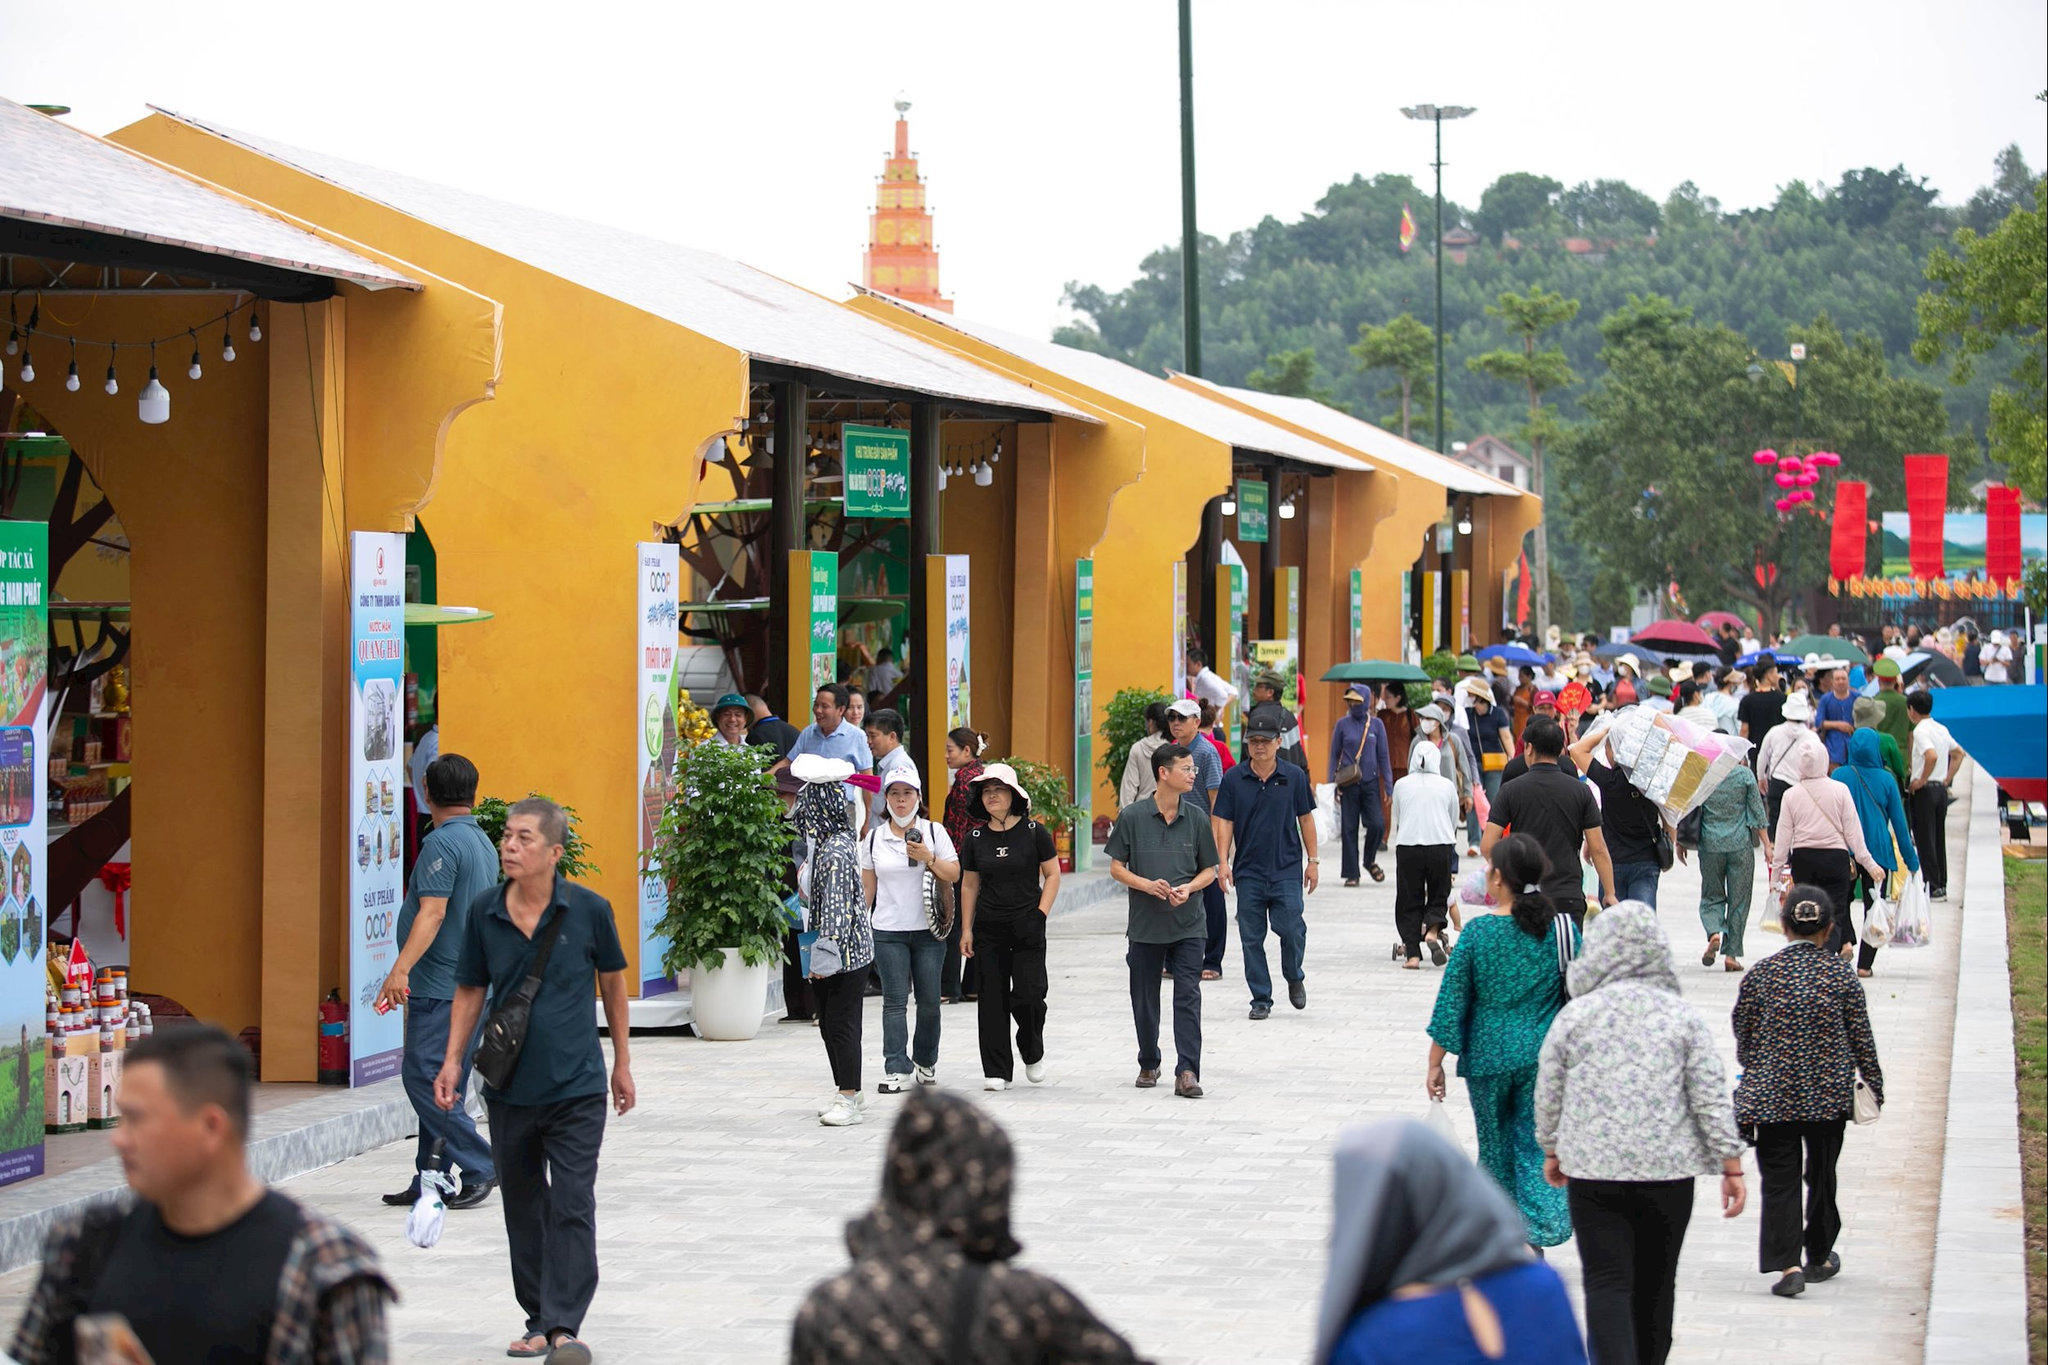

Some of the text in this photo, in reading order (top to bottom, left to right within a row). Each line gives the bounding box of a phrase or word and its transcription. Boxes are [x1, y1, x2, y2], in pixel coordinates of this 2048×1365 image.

[867, 468, 886, 497] OCOP
[8, 547, 23, 569] TÁC
[24, 547, 34, 569] XÃ
[6, 582, 22, 605] NAM
[23, 577, 41, 606] PHÁT
[650, 571, 671, 592] OCOP
[951, 593, 966, 611] OCOP
[358, 633, 401, 664] QUANG HẢI
[4, 830, 18, 841] OCOP
[363, 881, 395, 908] SẢN PHẨM
[647, 882, 662, 899] OCOP
[365, 911, 393, 941] OCOP
